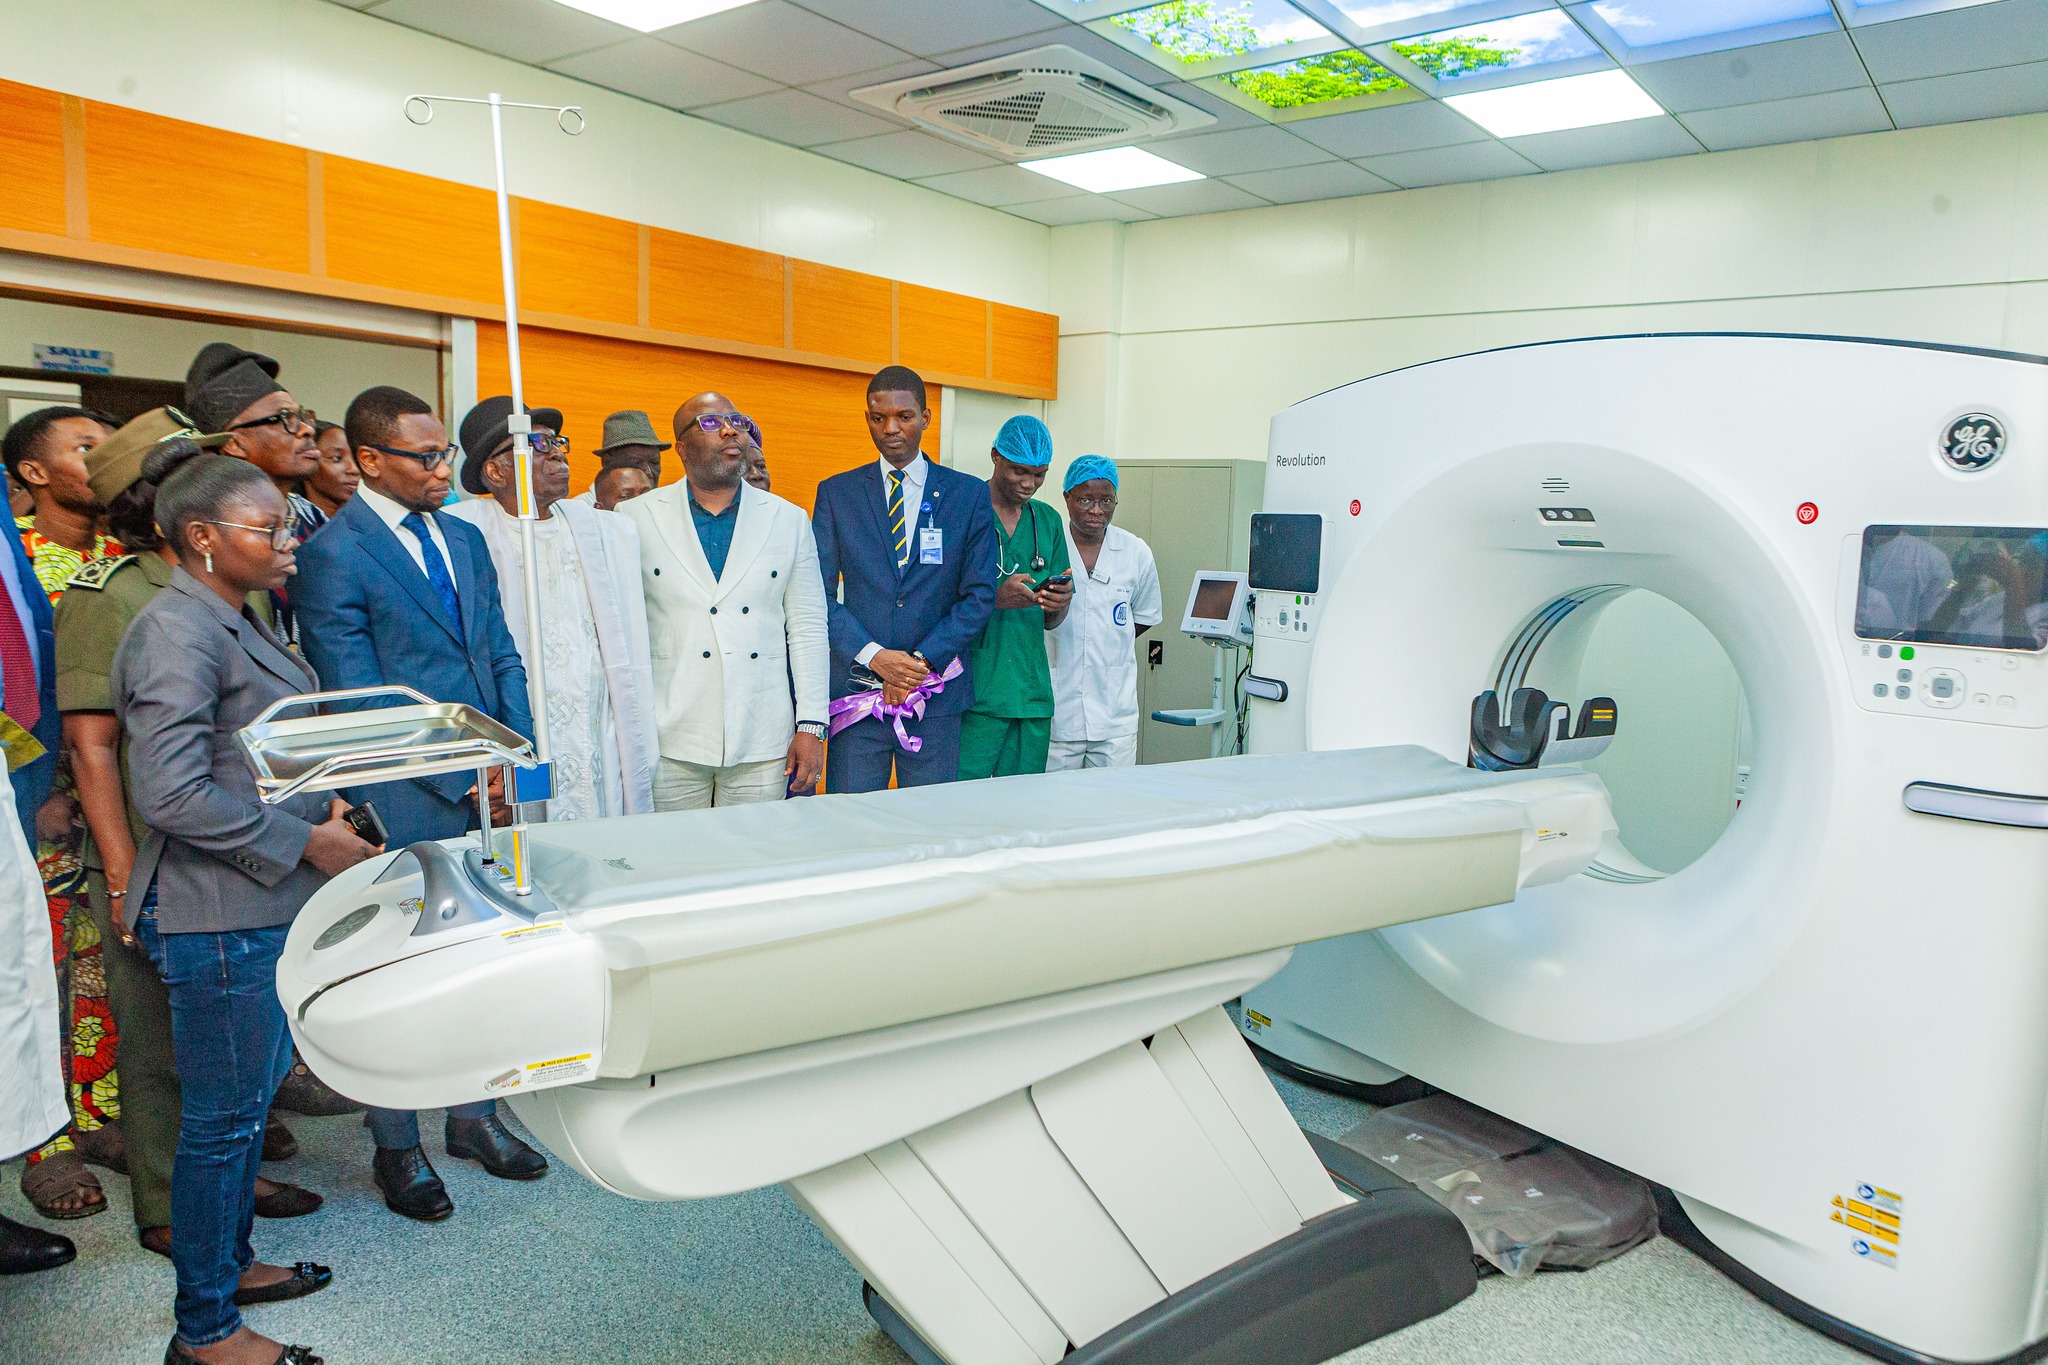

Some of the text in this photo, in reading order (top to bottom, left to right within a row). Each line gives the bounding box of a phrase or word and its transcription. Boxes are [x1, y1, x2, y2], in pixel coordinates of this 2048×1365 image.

[48, 345, 101, 360] SALLE
[1953, 425, 1993, 459] GE
[1276, 453, 1326, 467] Revolution
